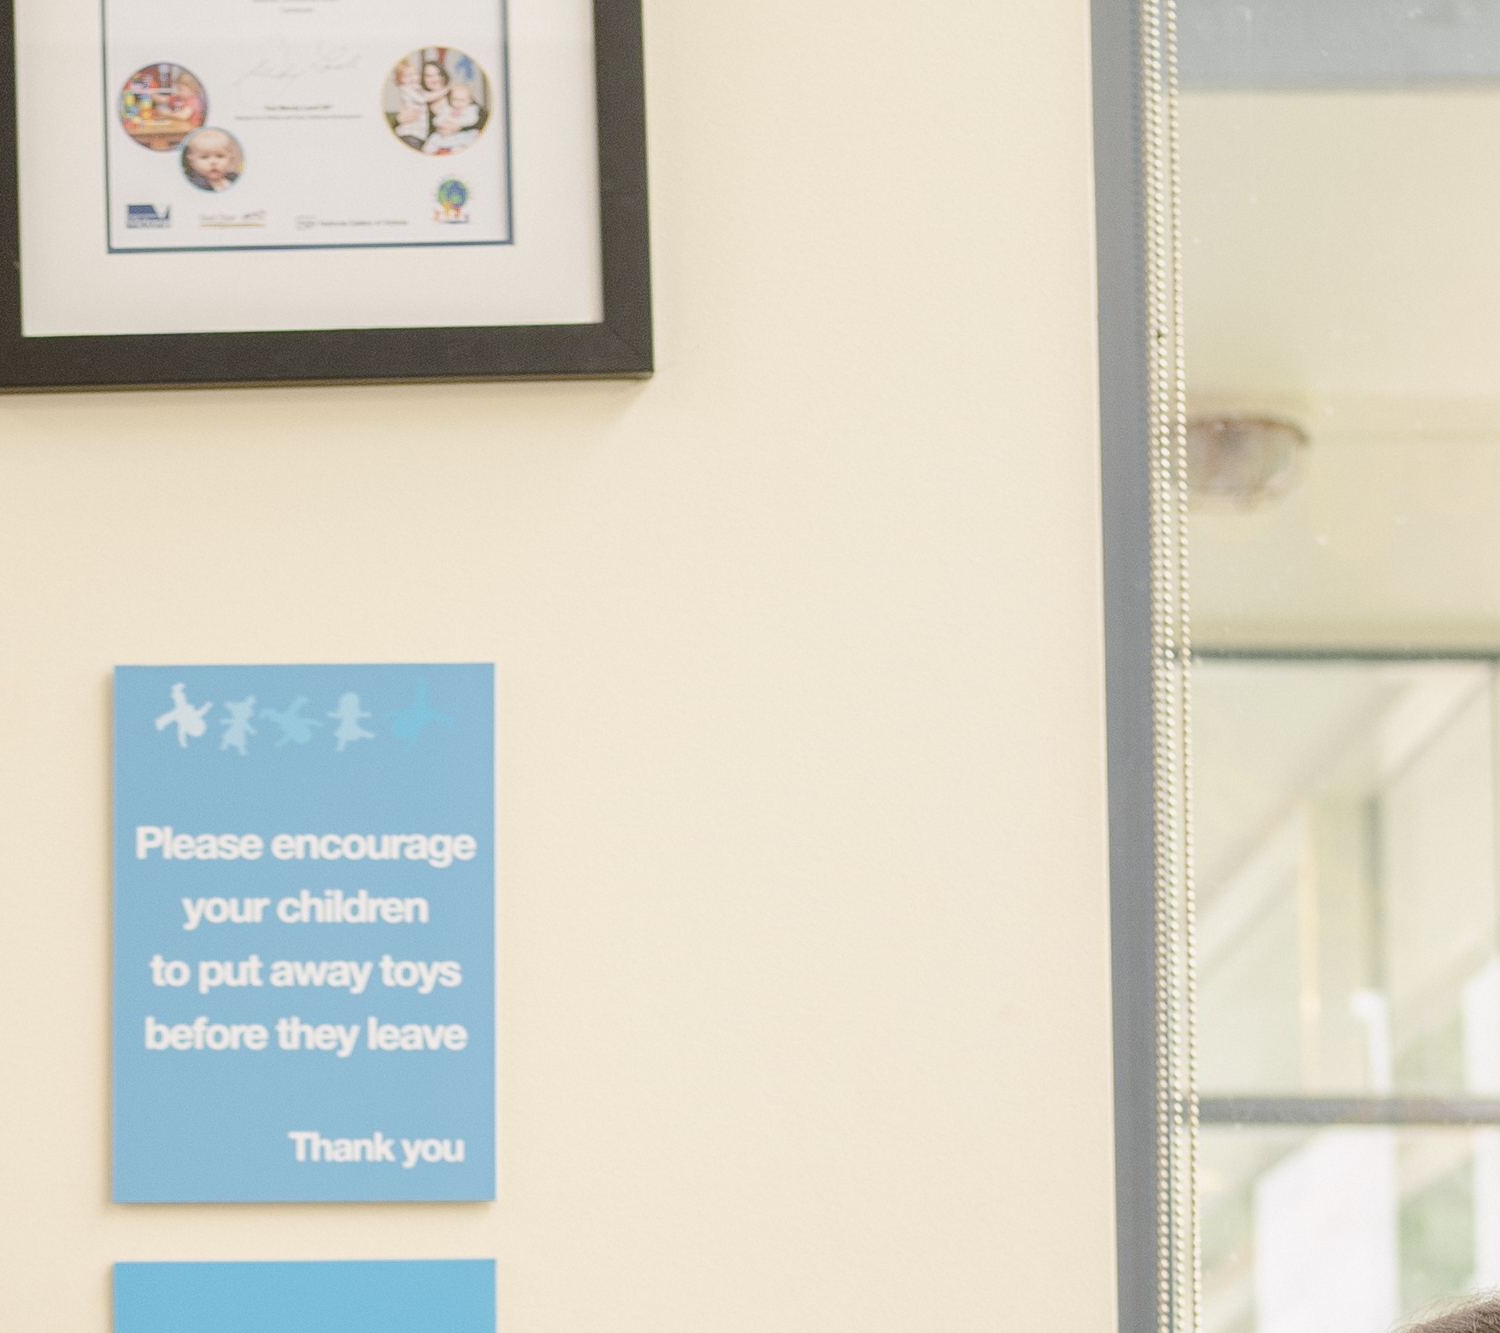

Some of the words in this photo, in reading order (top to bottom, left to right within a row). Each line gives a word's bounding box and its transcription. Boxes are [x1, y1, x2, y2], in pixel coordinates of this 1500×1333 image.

[135, 825, 264, 861] Please
[270, 833, 478, 868] encourage
[182, 896, 271, 931] your
[276, 889, 430, 924] children
[149, 954, 191, 988] to
[198, 954, 263, 995] put
[269, 959, 373, 995] away
[379, 954, 464, 995] toys
[144, 1016, 269, 1051] before
[275, 1016, 361, 1058] they
[367, 1016, 468, 1051] leave
[288, 1131, 397, 1163] Thank
[401, 1138, 466, 1169] you
